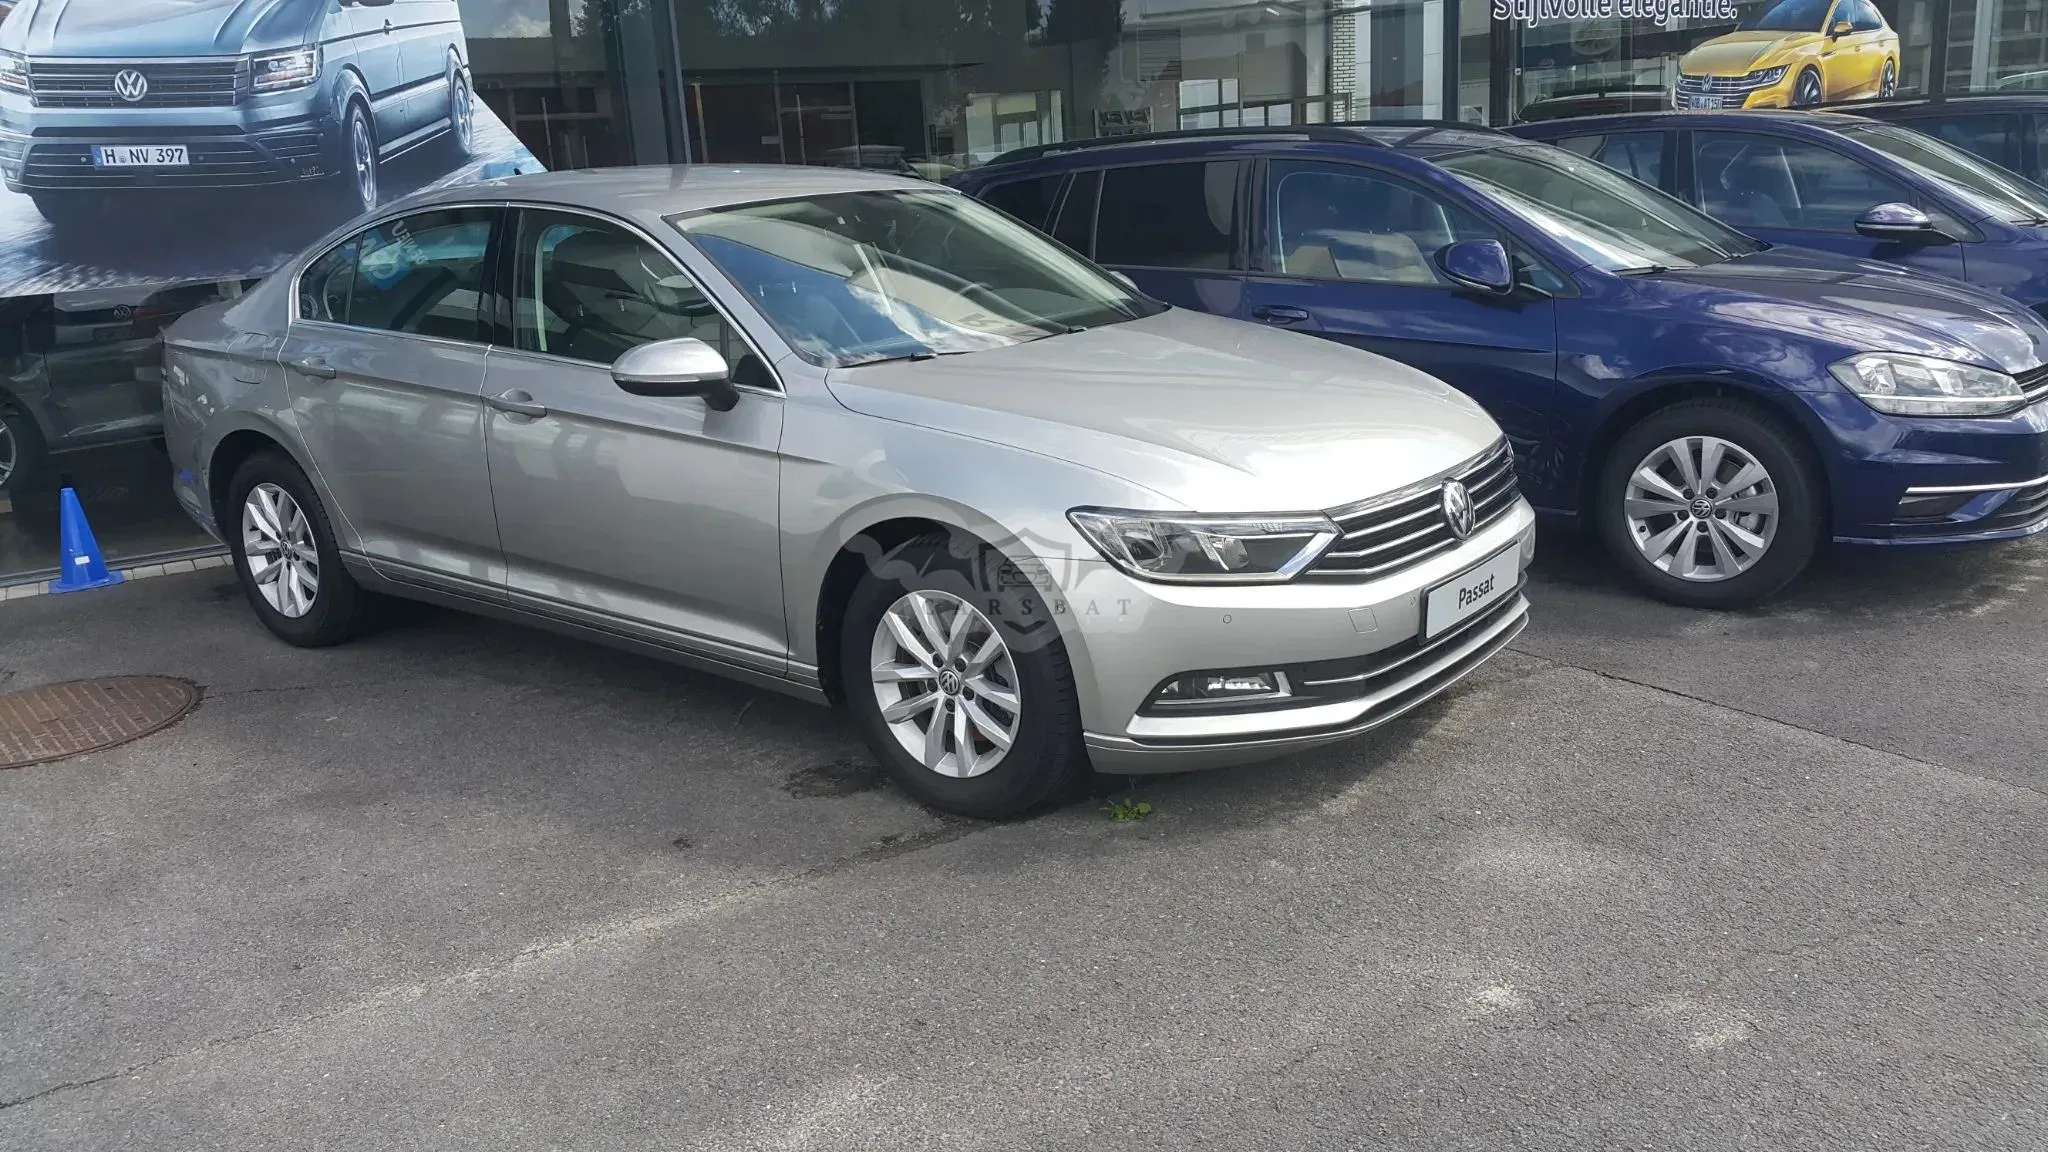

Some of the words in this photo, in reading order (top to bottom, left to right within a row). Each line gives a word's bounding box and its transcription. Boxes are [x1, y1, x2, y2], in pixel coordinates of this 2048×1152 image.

[1493, 0, 1611, 28] Stijlvolle
[1618, 0, 1738, 25] elegantie.
[104, 149, 117, 164] H
[130, 149, 150, 163] NV
[156, 148, 184, 163] 397
[1458, 573, 1495, 610] Passat
